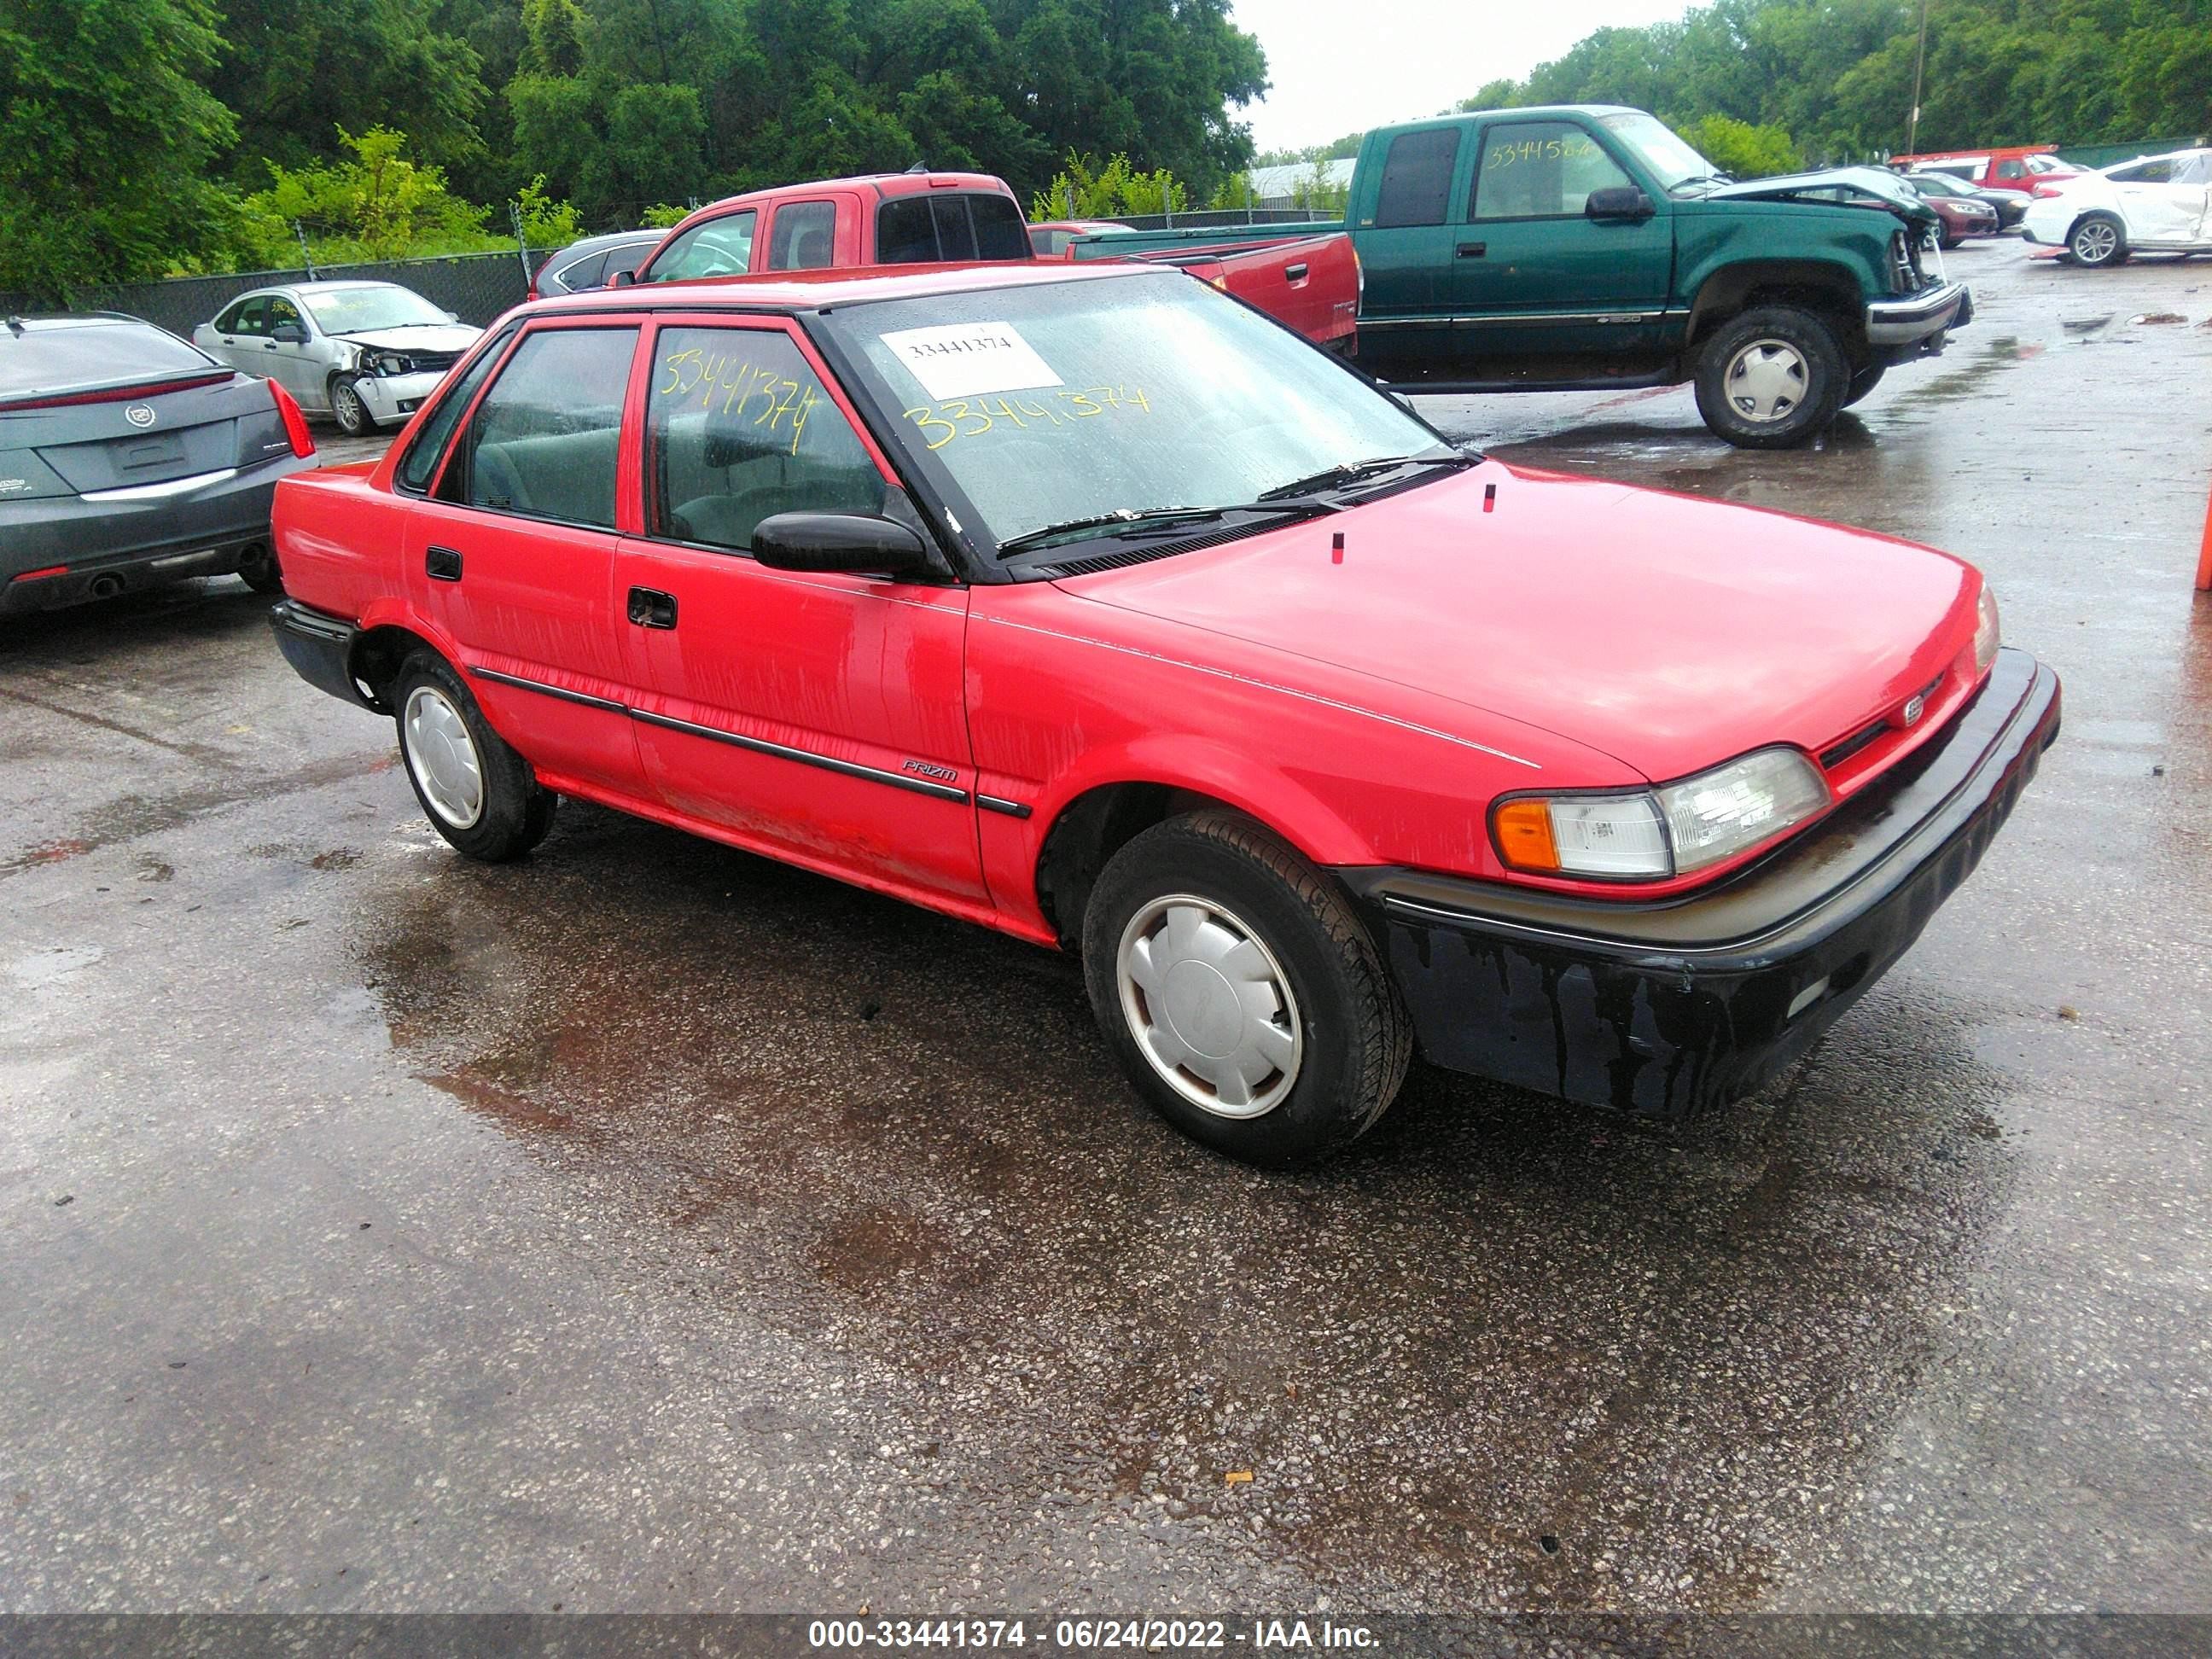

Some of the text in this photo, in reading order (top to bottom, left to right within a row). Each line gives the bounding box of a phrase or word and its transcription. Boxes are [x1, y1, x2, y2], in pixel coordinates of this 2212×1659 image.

[908, 336, 1013, 358] 33441374
[661, 348, 821, 457] 33441374
[902, 759, 957, 782] PRIZM
